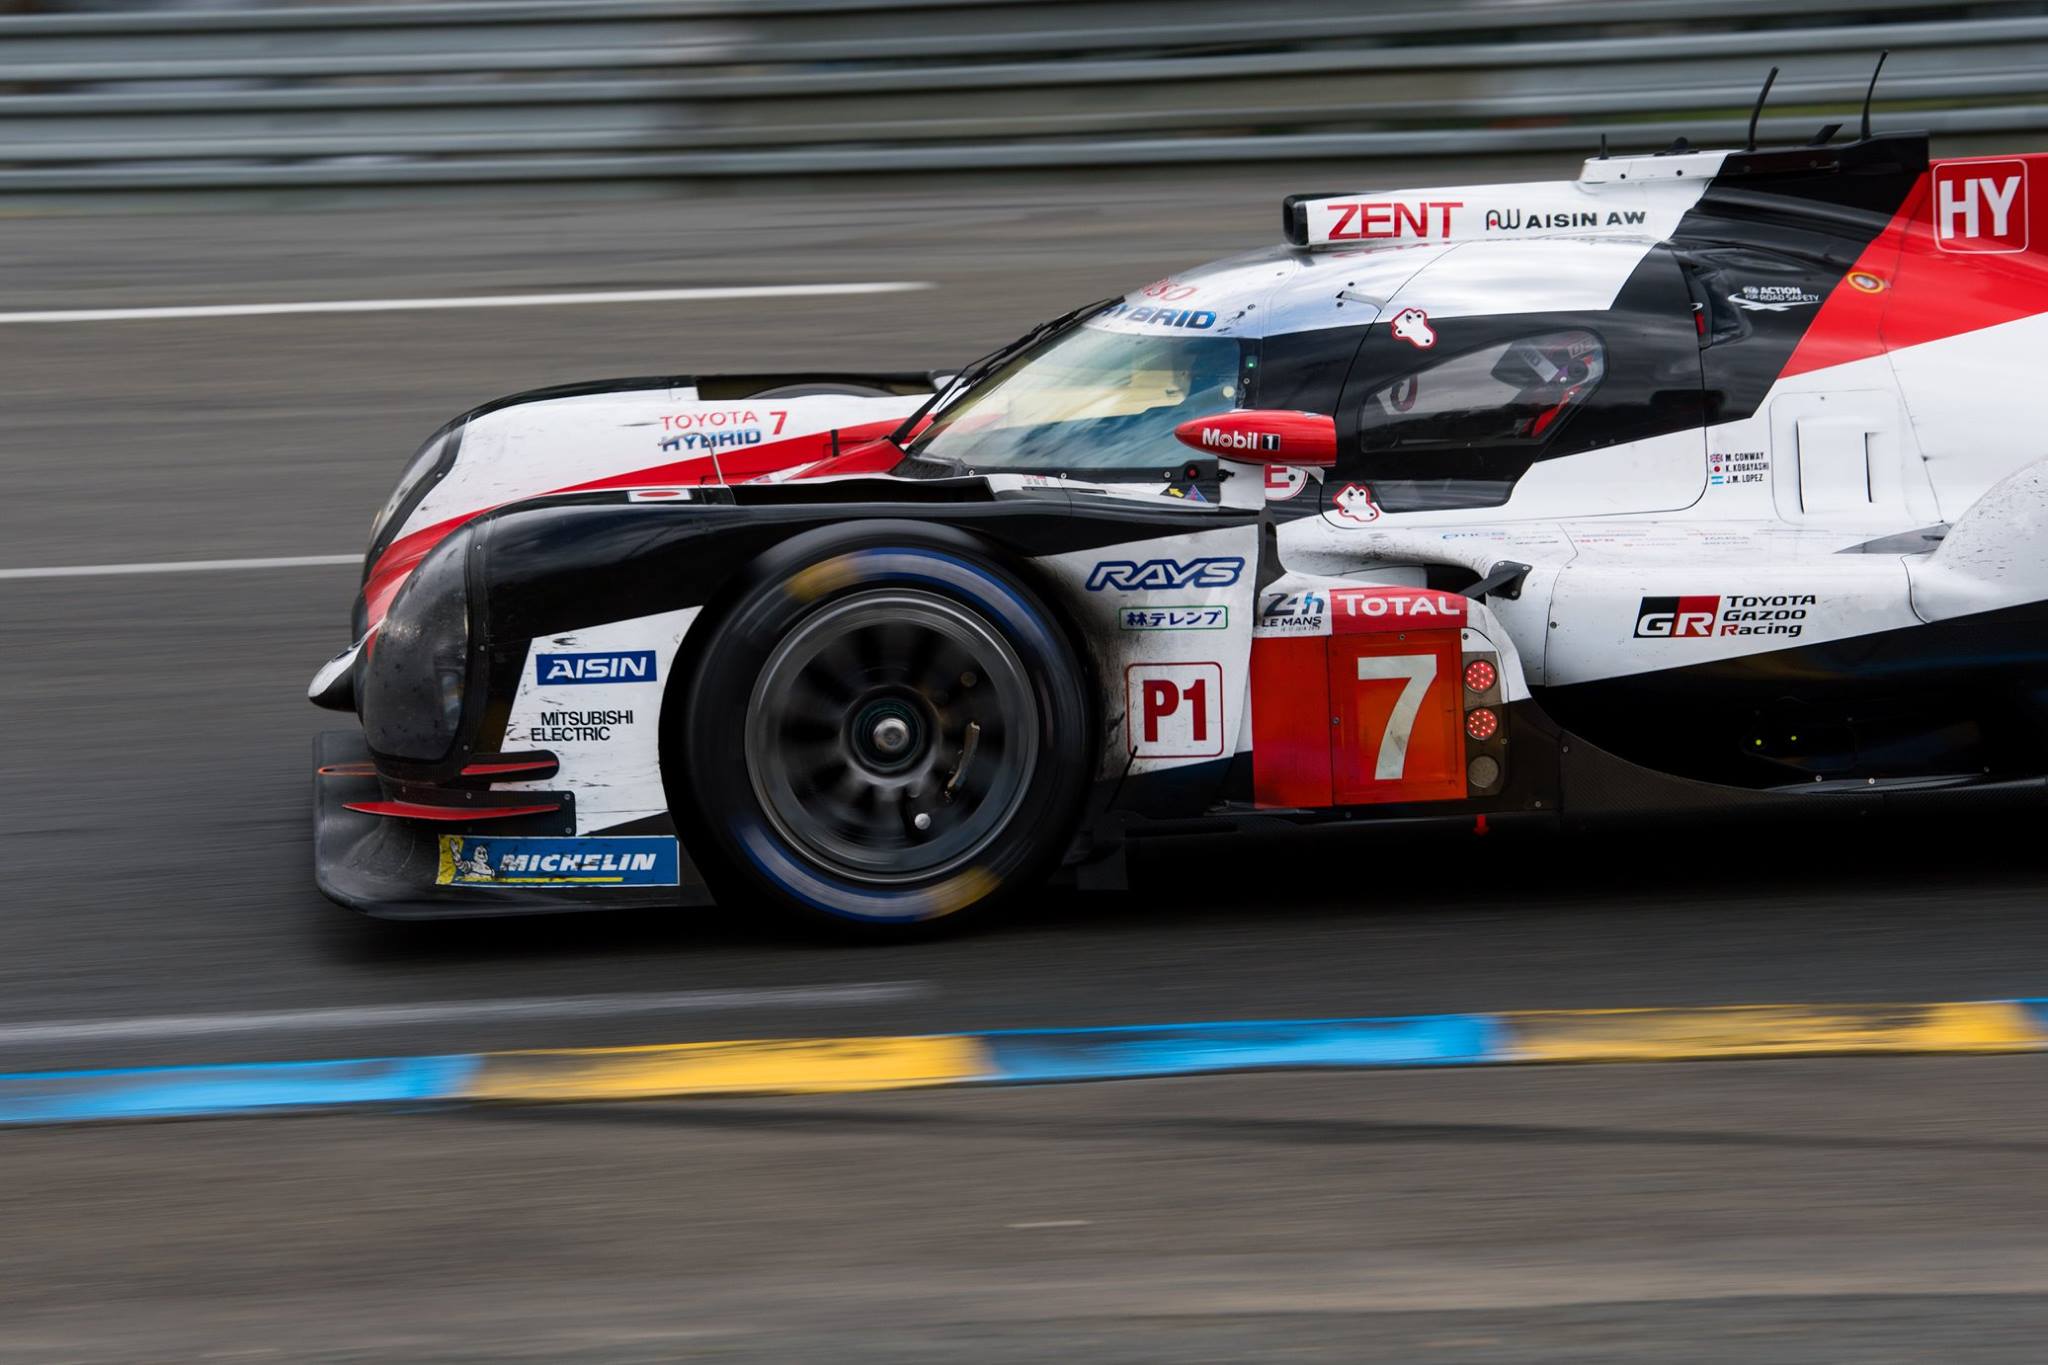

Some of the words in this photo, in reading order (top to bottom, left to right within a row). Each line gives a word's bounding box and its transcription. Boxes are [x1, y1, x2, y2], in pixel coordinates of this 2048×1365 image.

[1939, 176, 2022, 240] HY
[1327, 202, 1464, 241] ZENT
[1526, 213, 1598, 229] AISIN
[1606, 211, 1647, 226] AW
[1760, 294, 1785, 302] ROAD
[1785, 294, 1820, 302] SAFETY
[659, 411, 758, 431] TOYOTA
[769, 411, 788, 435] 7
[660, 428, 762, 452] HYBRID
[1202, 428, 1259, 450] Mobil
[1735, 452, 1764, 462] CONWAY
[1742, 474, 1764, 483] LOPEZ
[1088, 558, 1243, 590] RAYS
[1264, 592, 1325, 616] 24h
[1337, 594, 1461, 617] TOTAL
[1726, 595, 1816, 608] TOYOTA
[1126, 611, 1223, 627] 林テレンプ
[1262, 618, 1278, 628] LE
[1281, 617, 1322, 627] MANS
[1637, 612, 1714, 637] GR
[1723, 609, 1806, 622] GAZOO
[1720, 623, 1802, 638] Racing
[546, 656, 648, 680] AISIN
[541, 710, 634, 726] MITSUBISHI
[1142, 678, 1207, 742] P1
[1358, 654, 1438, 780] 7
[531, 727, 611, 741] ELECTRIC
[500, 853, 657, 872] MICHELIN
